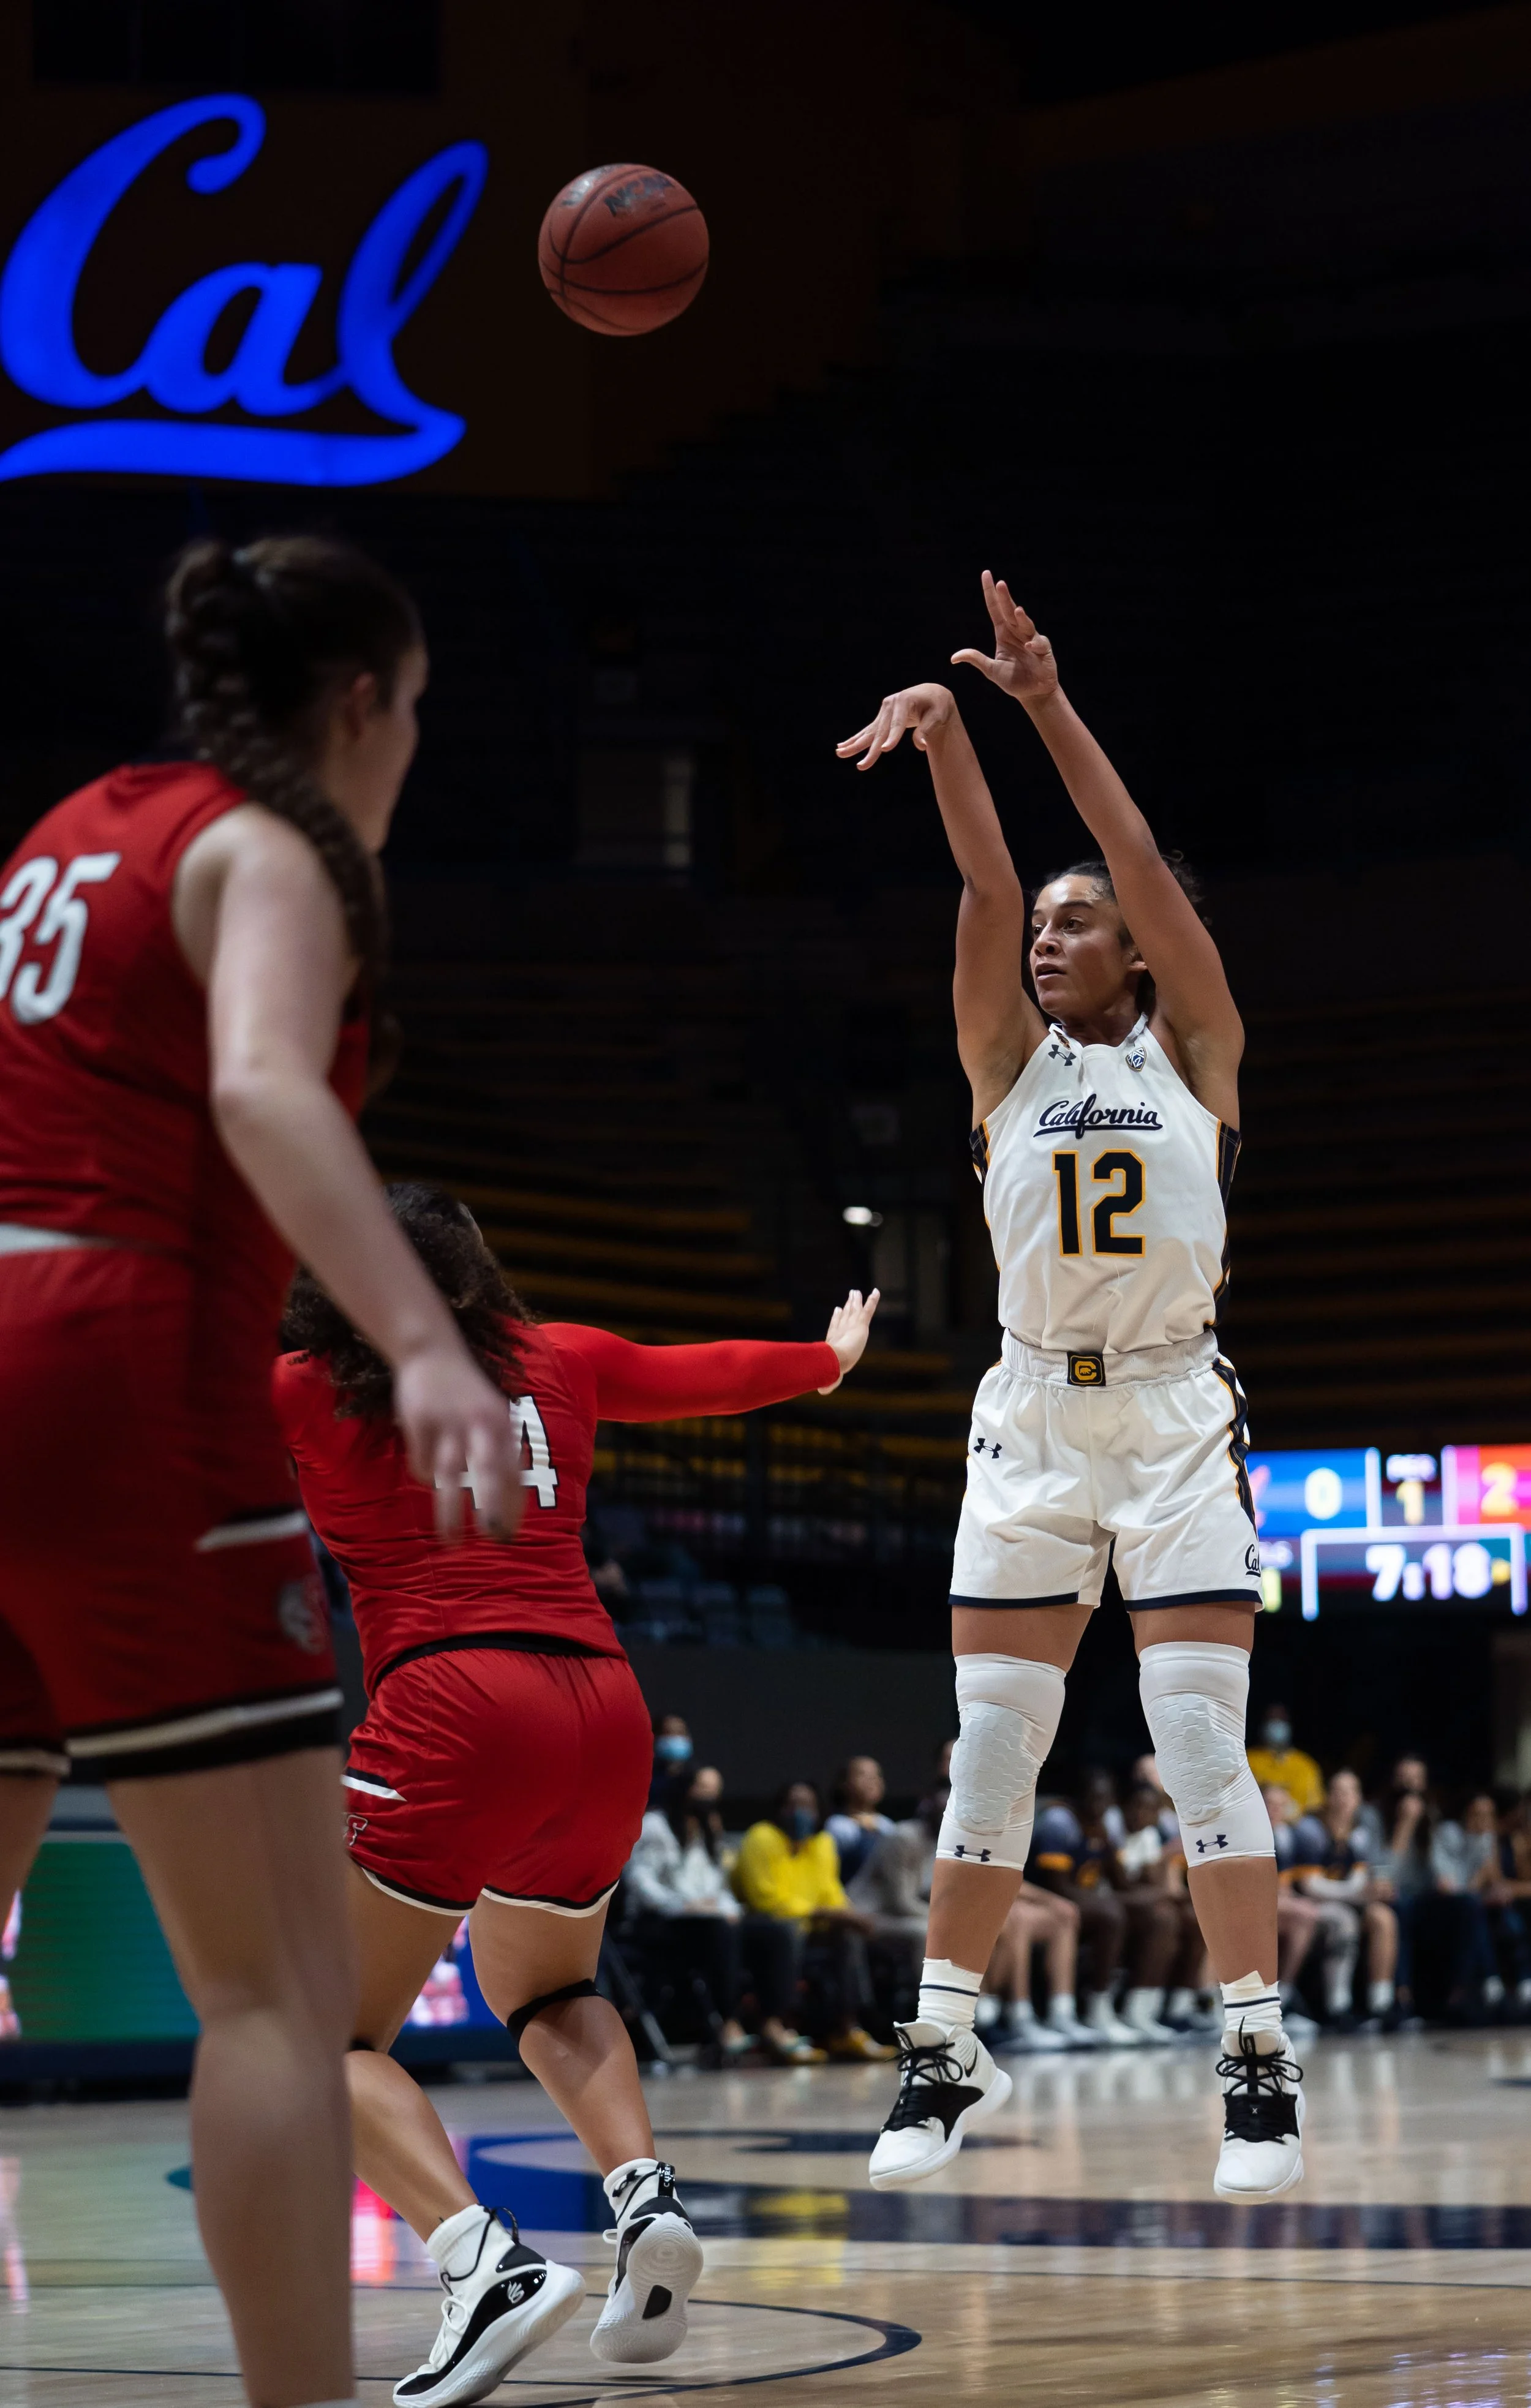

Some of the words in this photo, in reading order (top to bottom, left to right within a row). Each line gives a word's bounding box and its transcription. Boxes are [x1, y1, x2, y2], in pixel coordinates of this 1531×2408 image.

[0, 92, 489, 486] Cal
[1033, 1093, 1163, 1139] California
[1051, 1148, 1146, 1258] 12
[1304, 1467, 1342, 1520] 0
[1396, 1481, 1424, 1525] 1
[1480, 1462, 1518, 1516] 2
